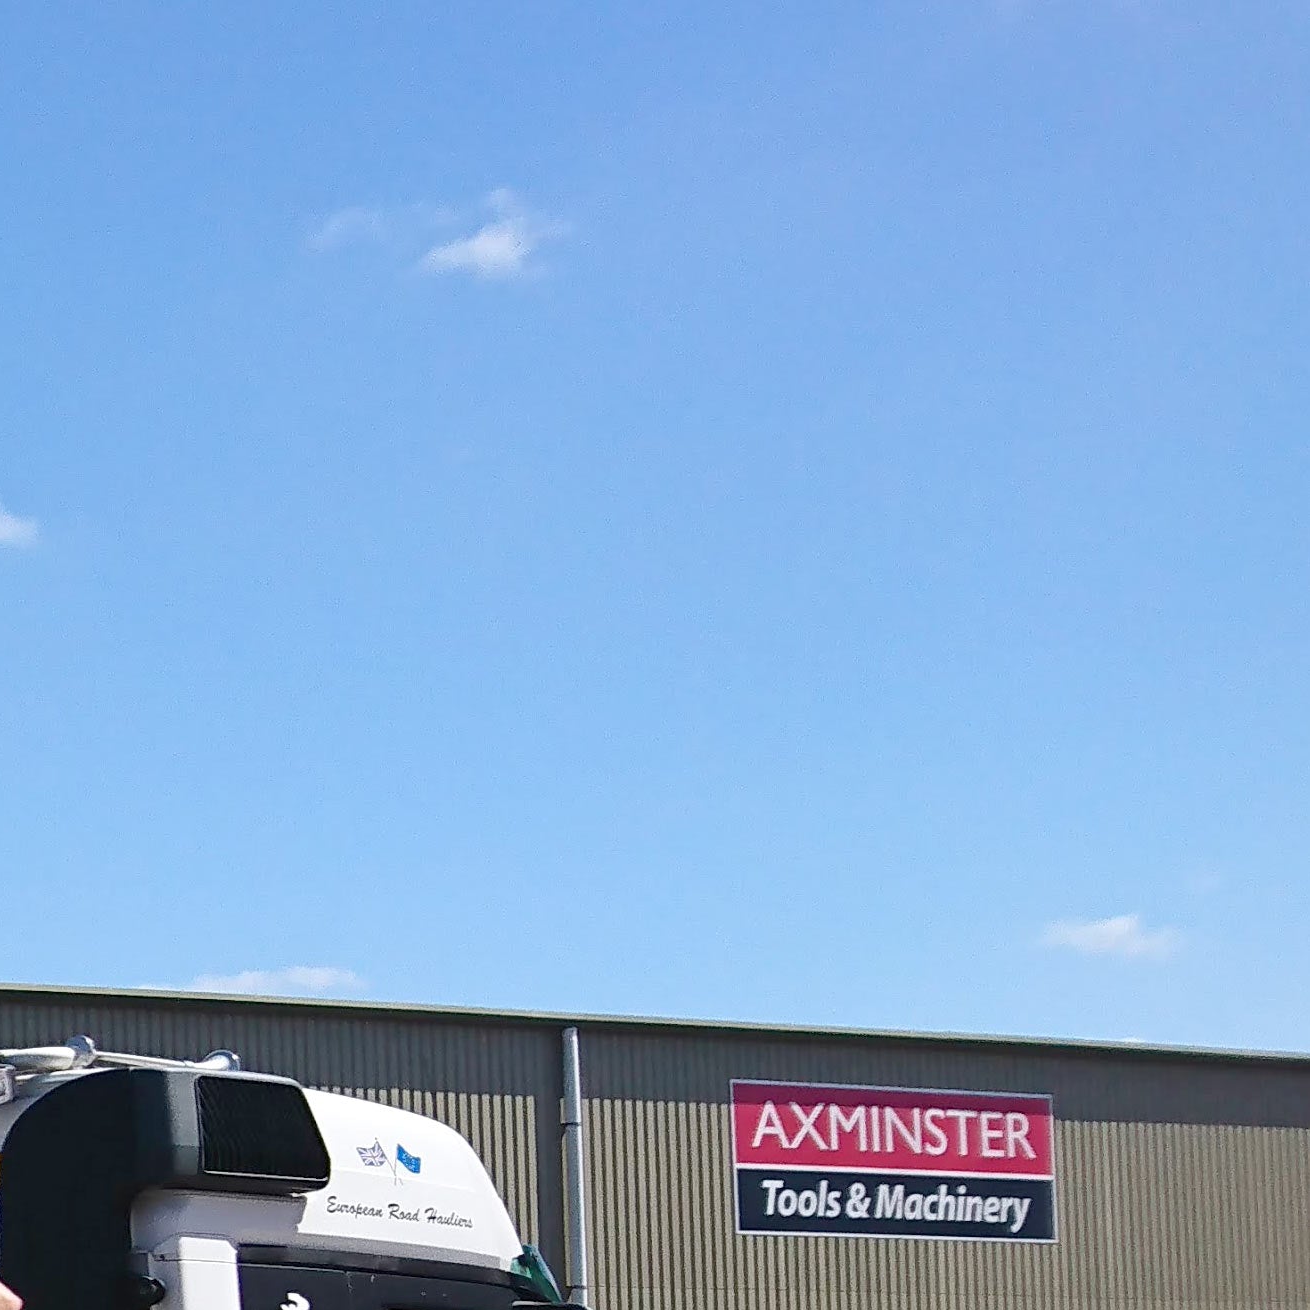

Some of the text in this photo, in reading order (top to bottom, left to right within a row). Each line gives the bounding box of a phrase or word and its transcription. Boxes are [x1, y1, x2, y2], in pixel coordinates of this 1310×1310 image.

[751, 1100, 1037, 1160] AXMINSTER
[327, 1196, 473, 1228] European Road Hauliers
[760, 1179, 1031, 1234] Tools & Machinery
